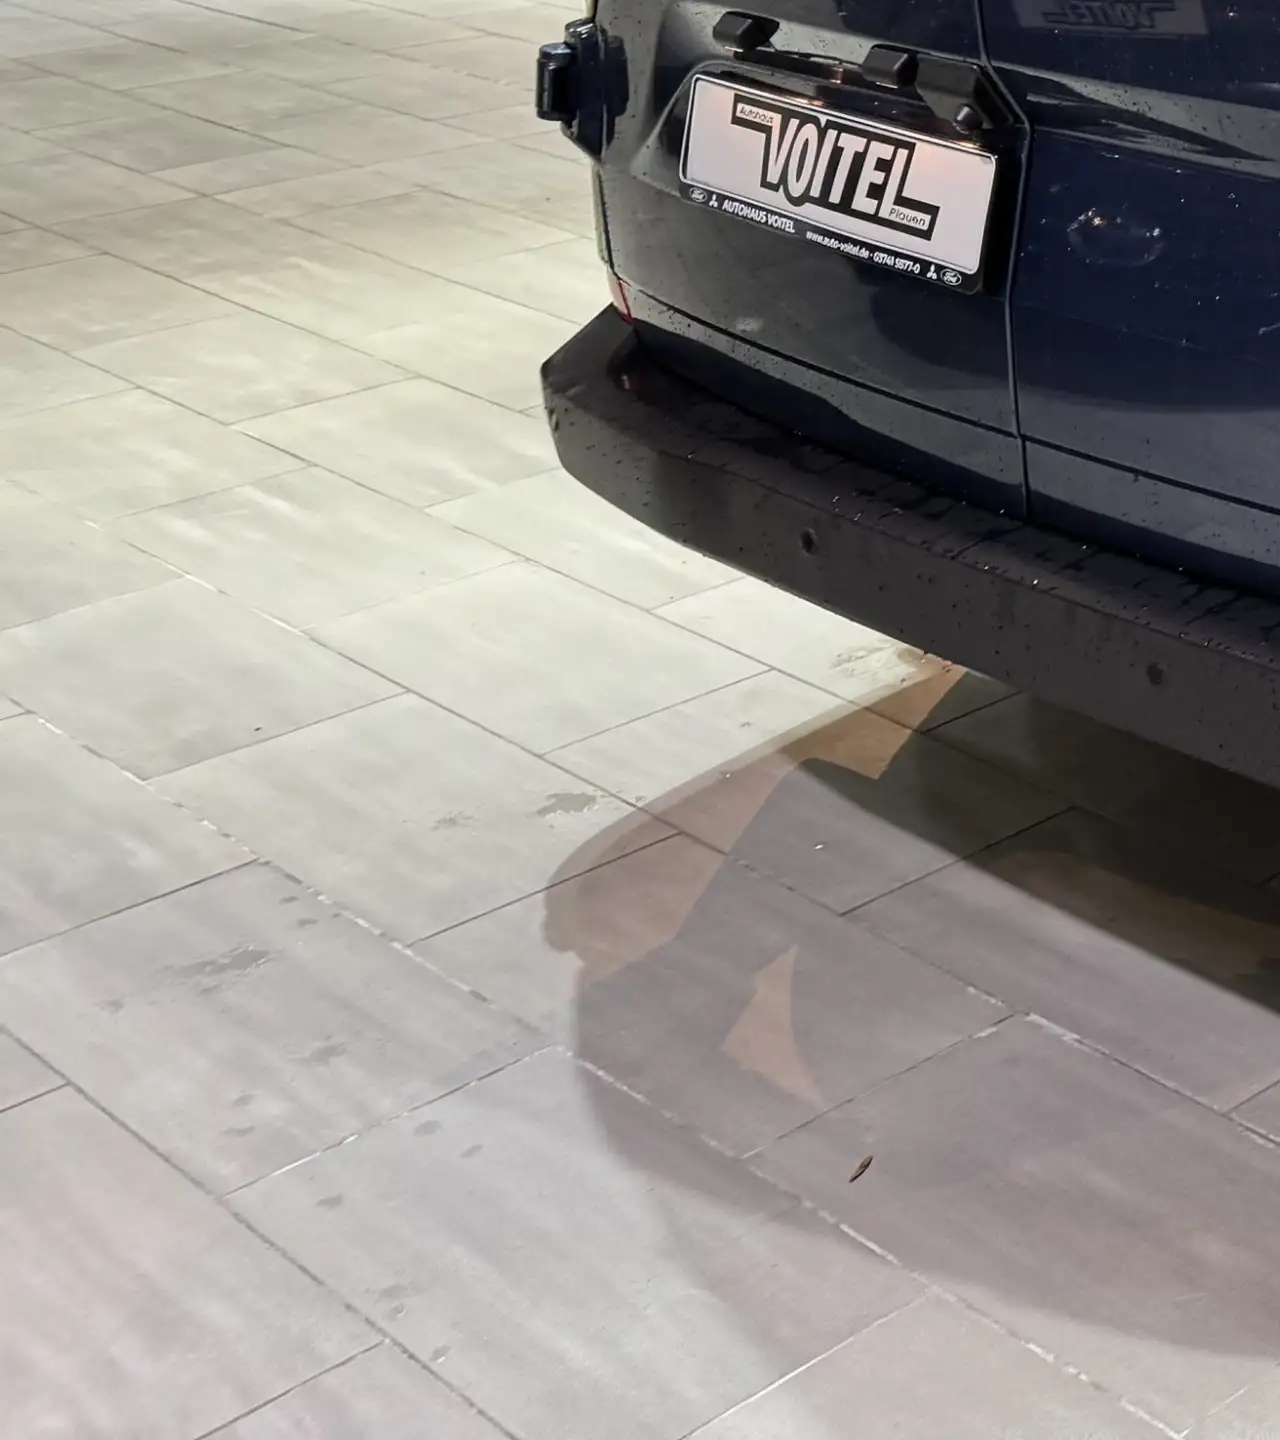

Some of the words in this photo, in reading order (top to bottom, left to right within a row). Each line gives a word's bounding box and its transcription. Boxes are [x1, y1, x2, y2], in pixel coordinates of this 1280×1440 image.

[738, 106, 775, 125] Autohaus
[764, 112, 914, 221] VOITEL
[722, 199, 767, 223] AUTOHAUS
[767, 214, 796, 234] VOITEL
[888, 207, 927, 227] Plauen
